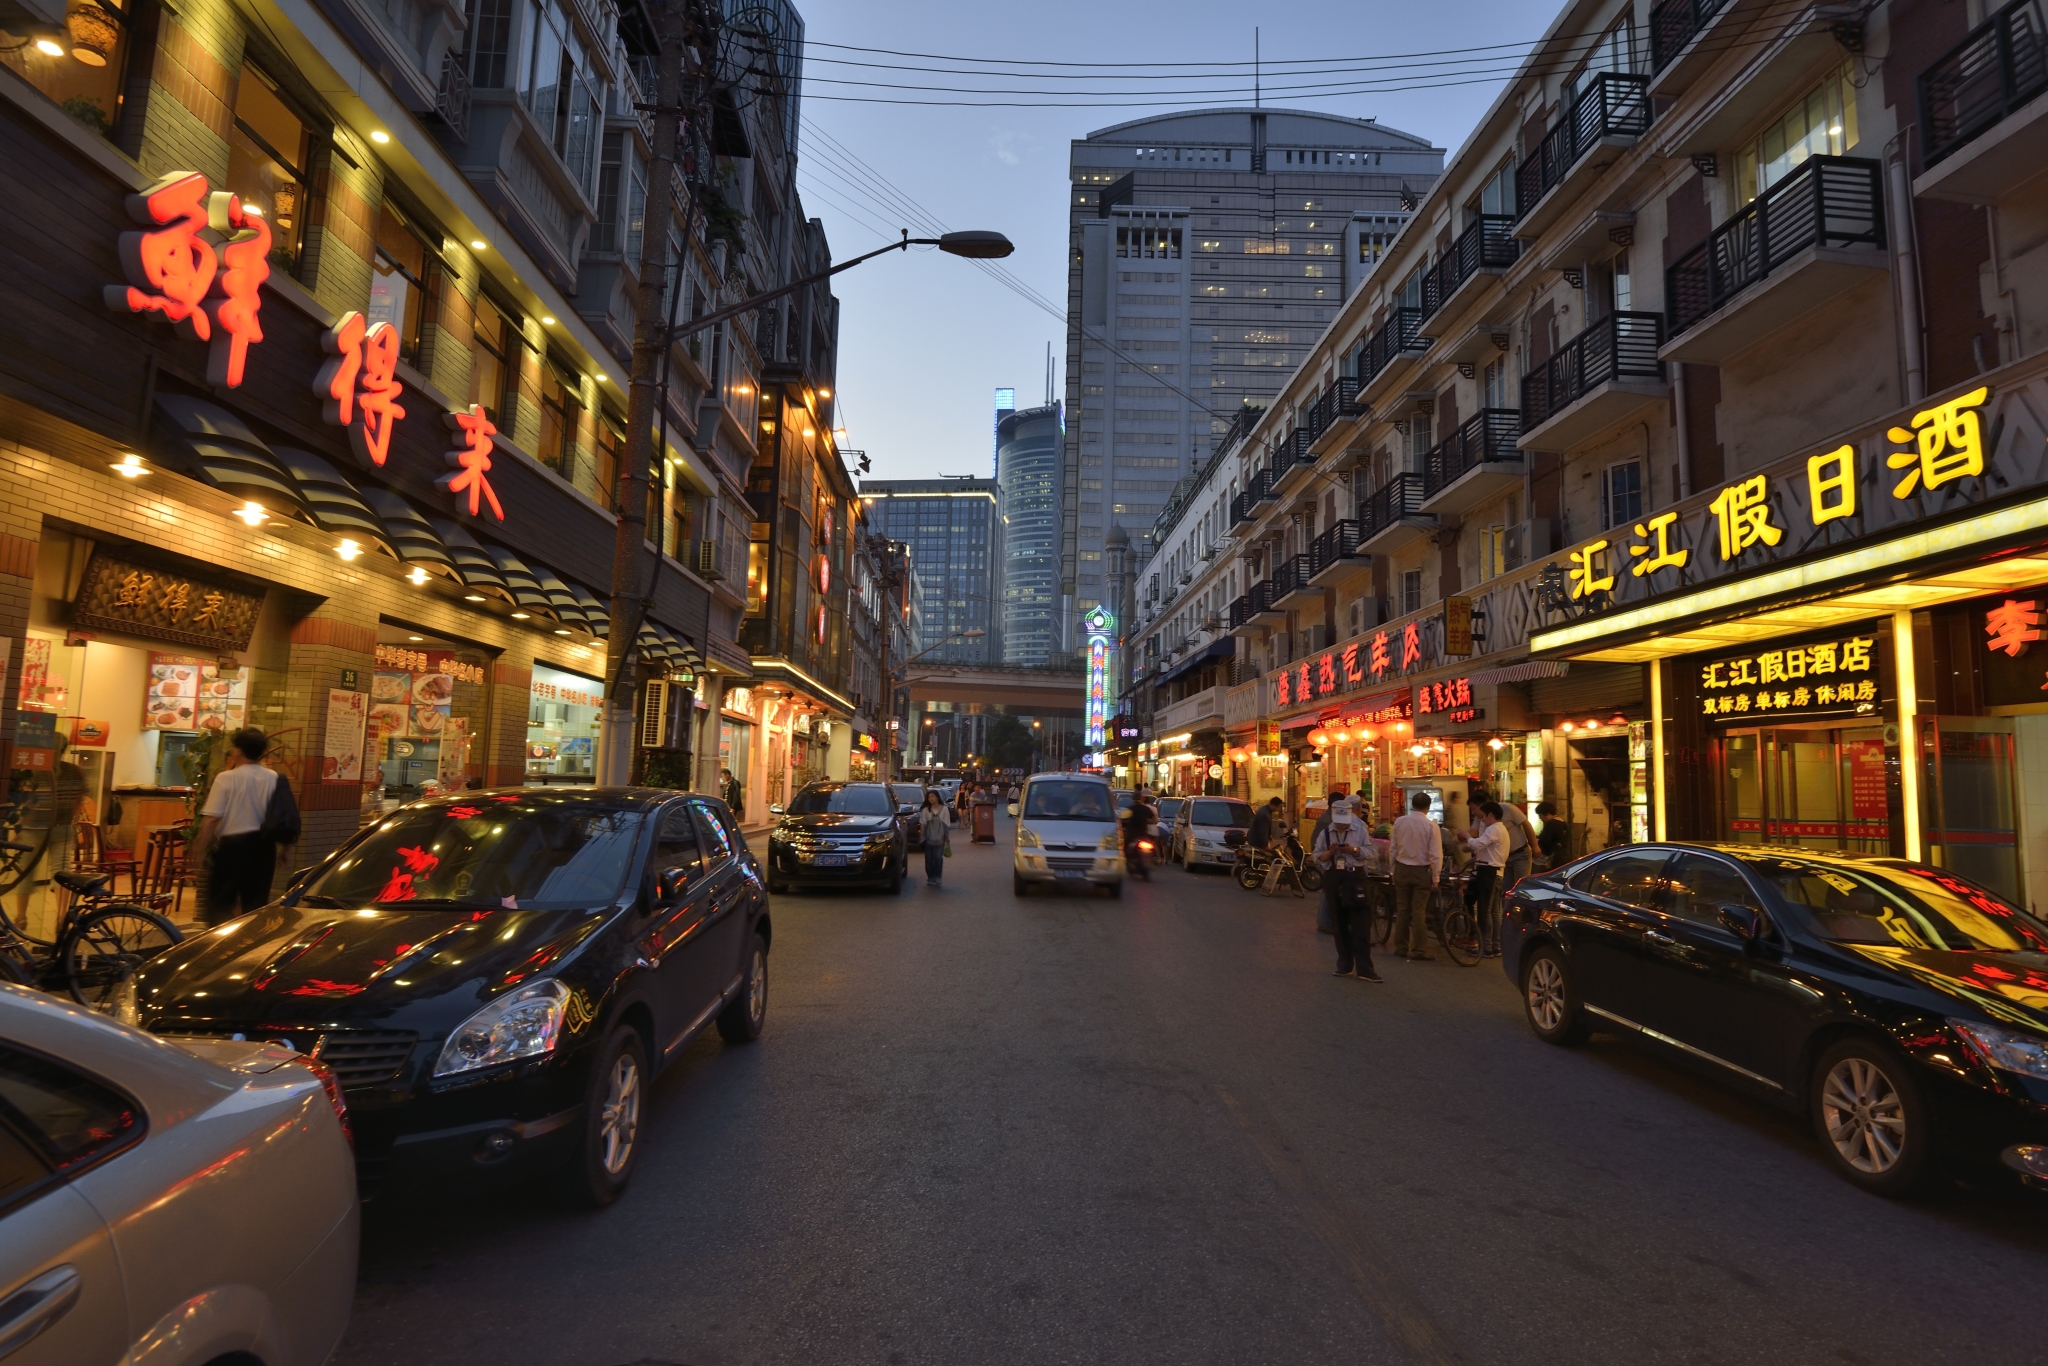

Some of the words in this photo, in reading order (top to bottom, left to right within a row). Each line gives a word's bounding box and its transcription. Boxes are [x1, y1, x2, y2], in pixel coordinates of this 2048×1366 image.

[375, 643, 428, 673] 中华老字号
[439, 658, 485, 685] 中华名小吃
[1277, 620, 1421, 706] 盛鑫热气羊肉
[1701, 636, 1874, 689] 汇江假日酒店
[345, 671, 355, 682] 36
[560, 687, 588, 706] 中华名小吃
[1418, 677, 1471, 714] 盛鑫火锅
[1702, 693, 1751, 715] 双标房
[1755, 686, 1811, 711] 单标房
[1815, 679, 1878, 705] 休闲房
